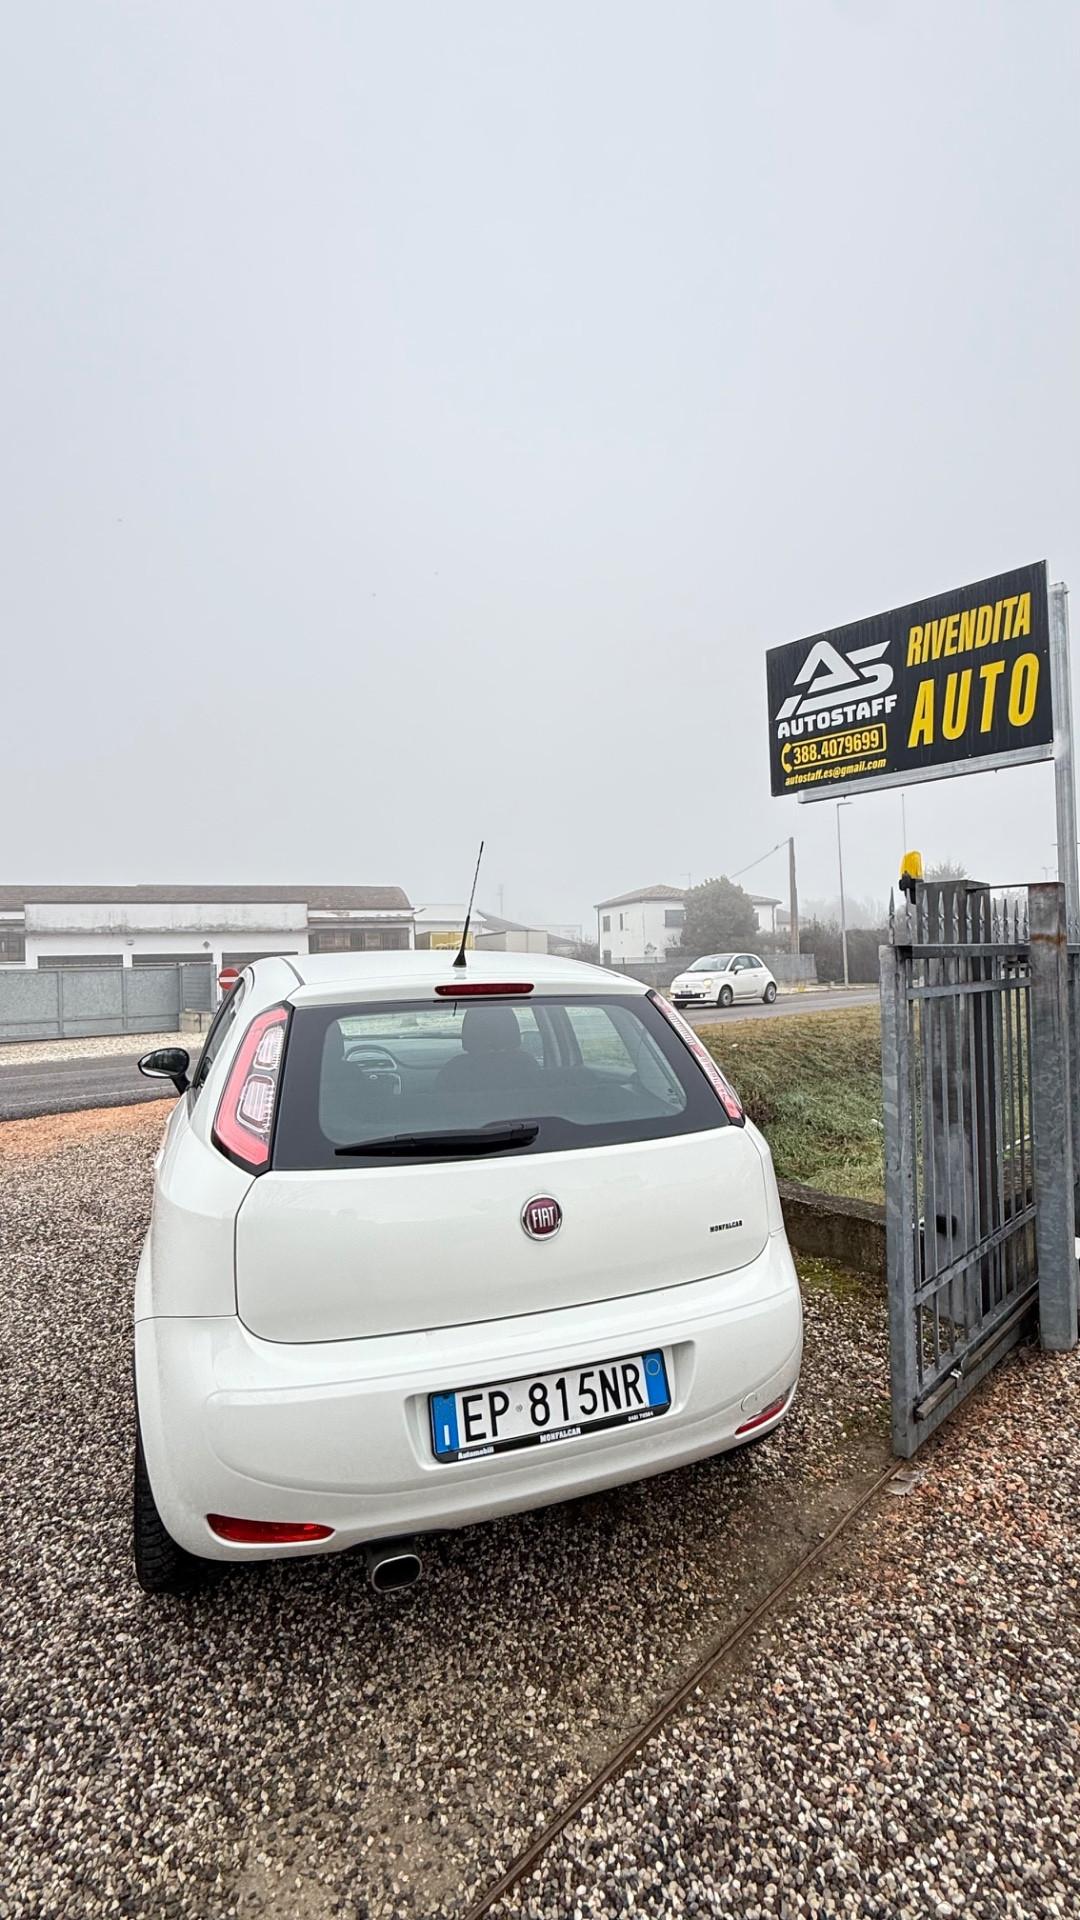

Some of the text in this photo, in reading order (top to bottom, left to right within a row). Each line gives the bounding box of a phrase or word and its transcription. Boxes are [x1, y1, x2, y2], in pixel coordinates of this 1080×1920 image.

[906, 592, 1031, 667] RIVENDITA
[777, 694, 898, 739] AUTOSTAFF
[907, 652, 1040, 748] AUTO
[793, 729, 880, 765] 388.4079699
[784, 758, 887, 786] autostaff.es@gmail.com
[531, 1206, 555, 1229] FIAT
[457, 1446, 495, 1460] Automobili
